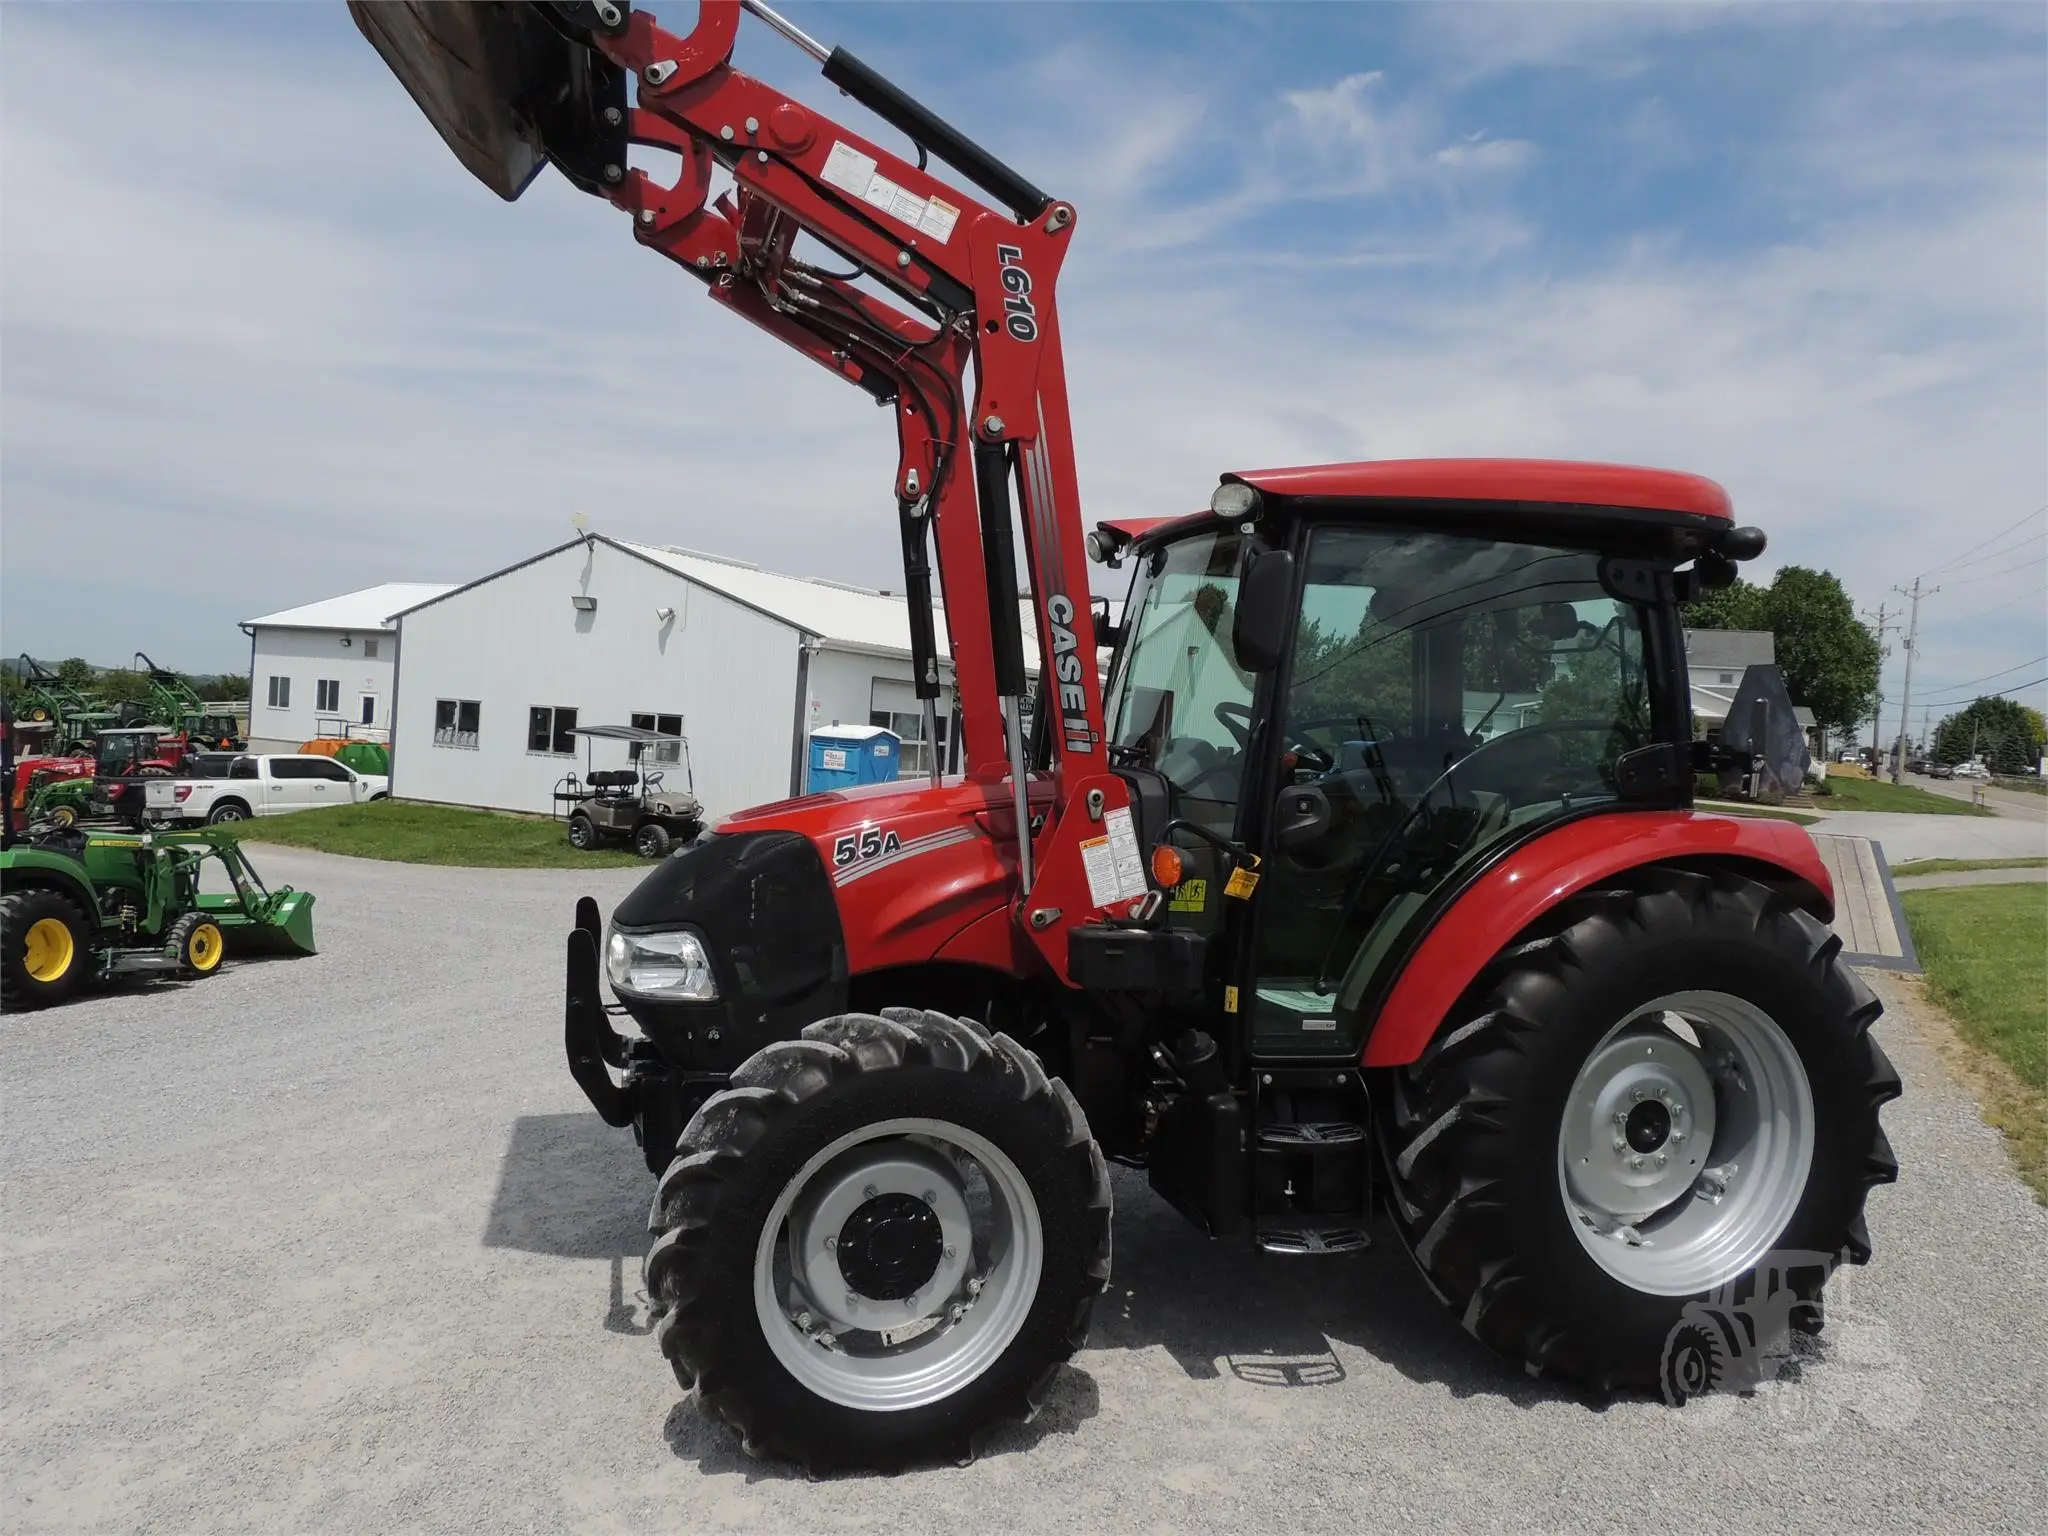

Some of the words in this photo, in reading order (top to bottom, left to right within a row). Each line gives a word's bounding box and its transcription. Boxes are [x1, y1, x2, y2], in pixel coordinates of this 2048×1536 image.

[997, 243, 1038, 342] L610
[1048, 593, 1087, 713] CASE
[833, 827, 903, 867] 55A
